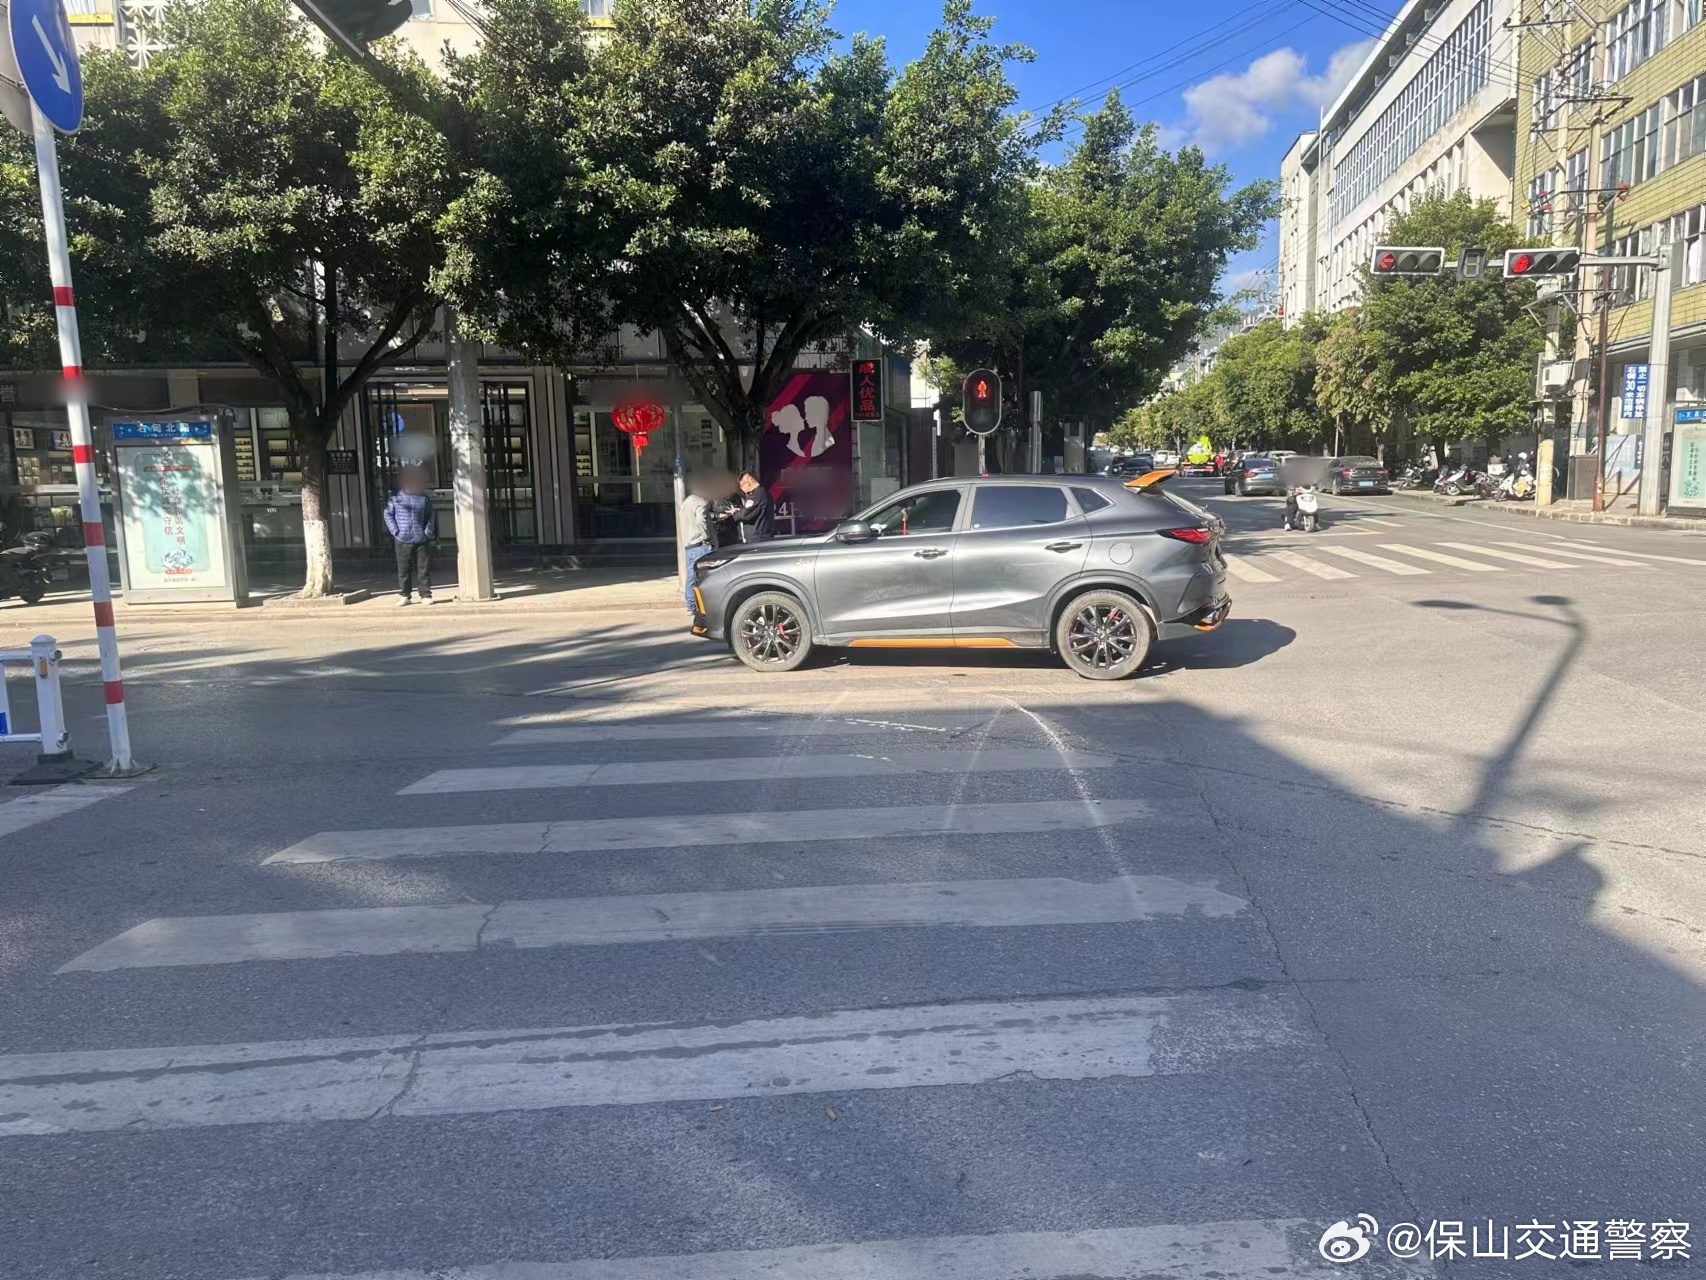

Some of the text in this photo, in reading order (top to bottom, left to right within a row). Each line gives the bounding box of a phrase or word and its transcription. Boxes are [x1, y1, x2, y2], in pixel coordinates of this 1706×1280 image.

[1634, 366, 1648, 418] 禁止一切车辆停放
